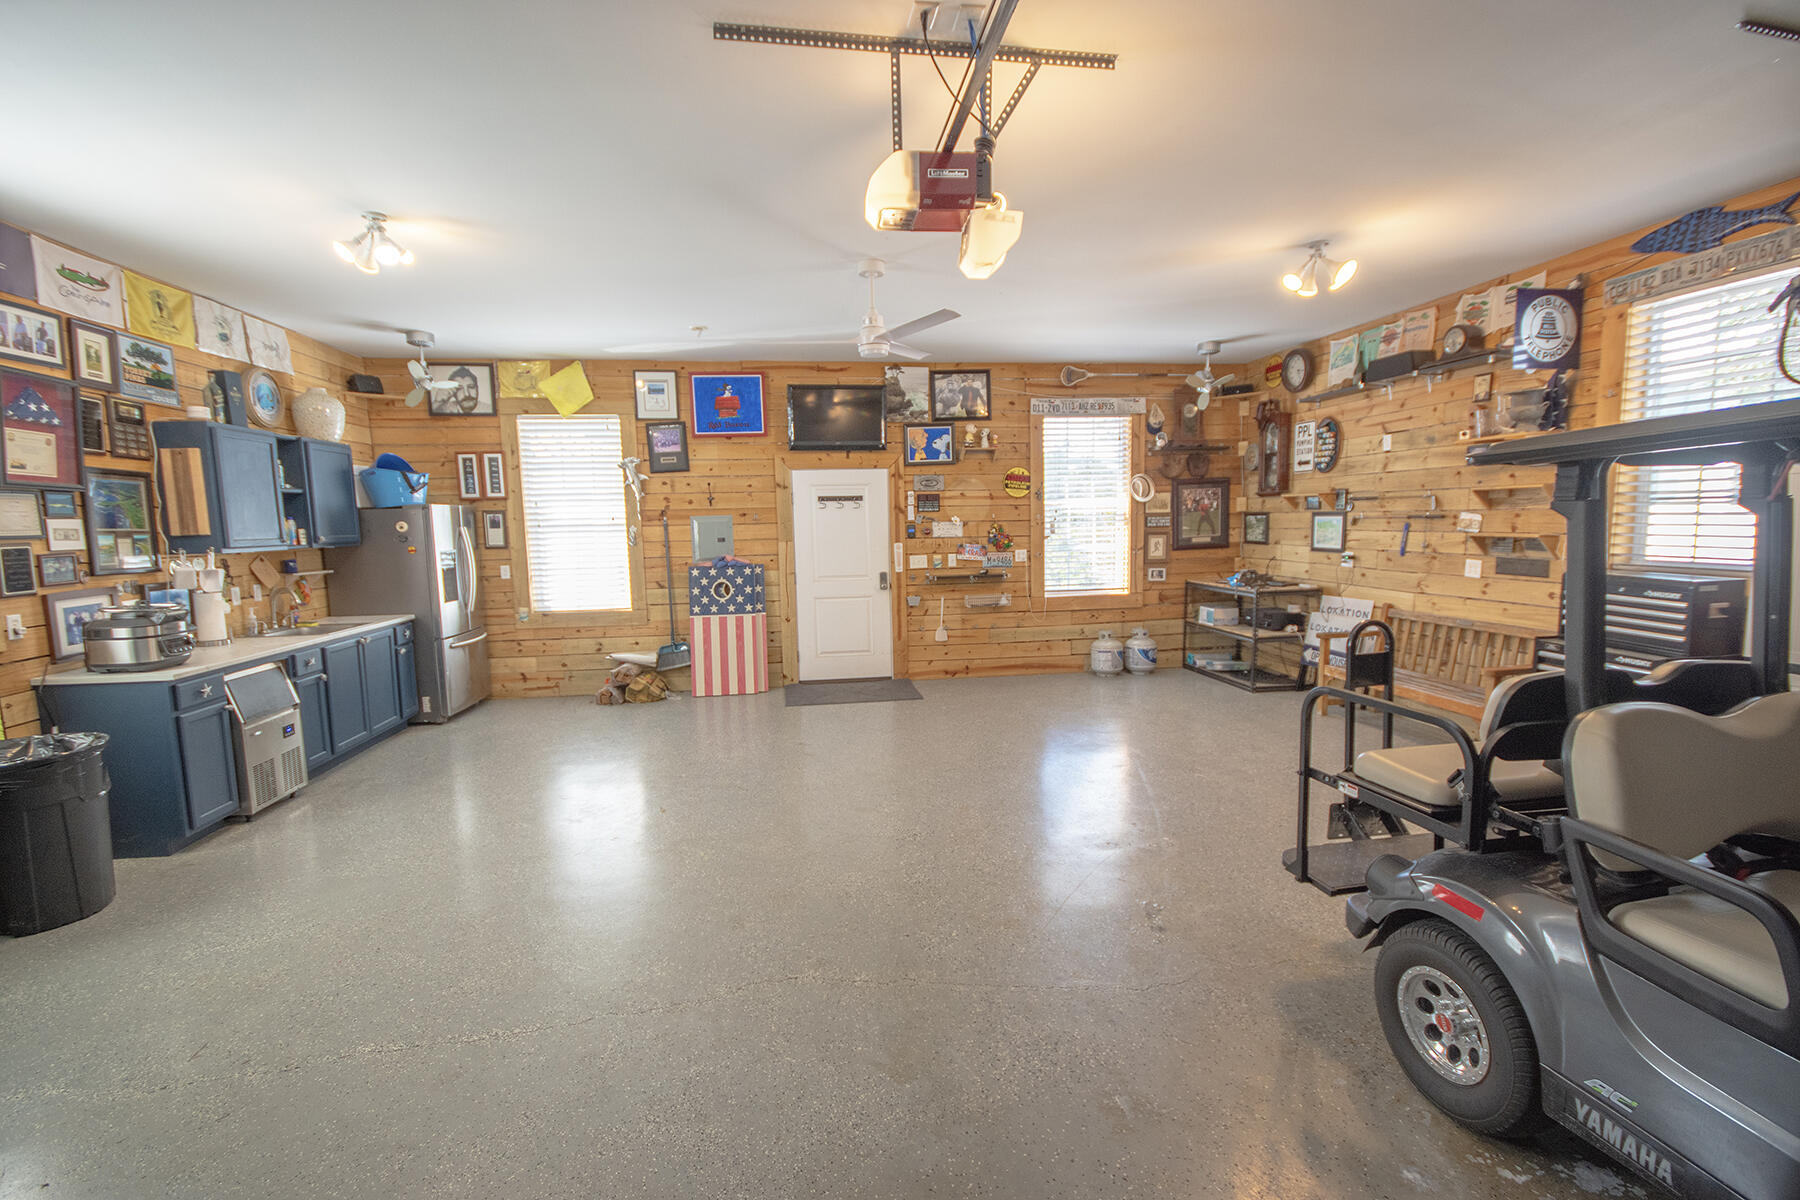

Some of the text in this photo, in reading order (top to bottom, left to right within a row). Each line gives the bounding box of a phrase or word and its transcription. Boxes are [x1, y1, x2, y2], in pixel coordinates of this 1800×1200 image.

[1531, 297, 1569, 314] PUBLIC
[1524, 335, 1574, 360] TELEPHONE
[1298, 424, 1312, 438] PPL
[1321, 606, 1370, 619] LOKATION
[1575, 1097, 1673, 1186] YAMAHA
